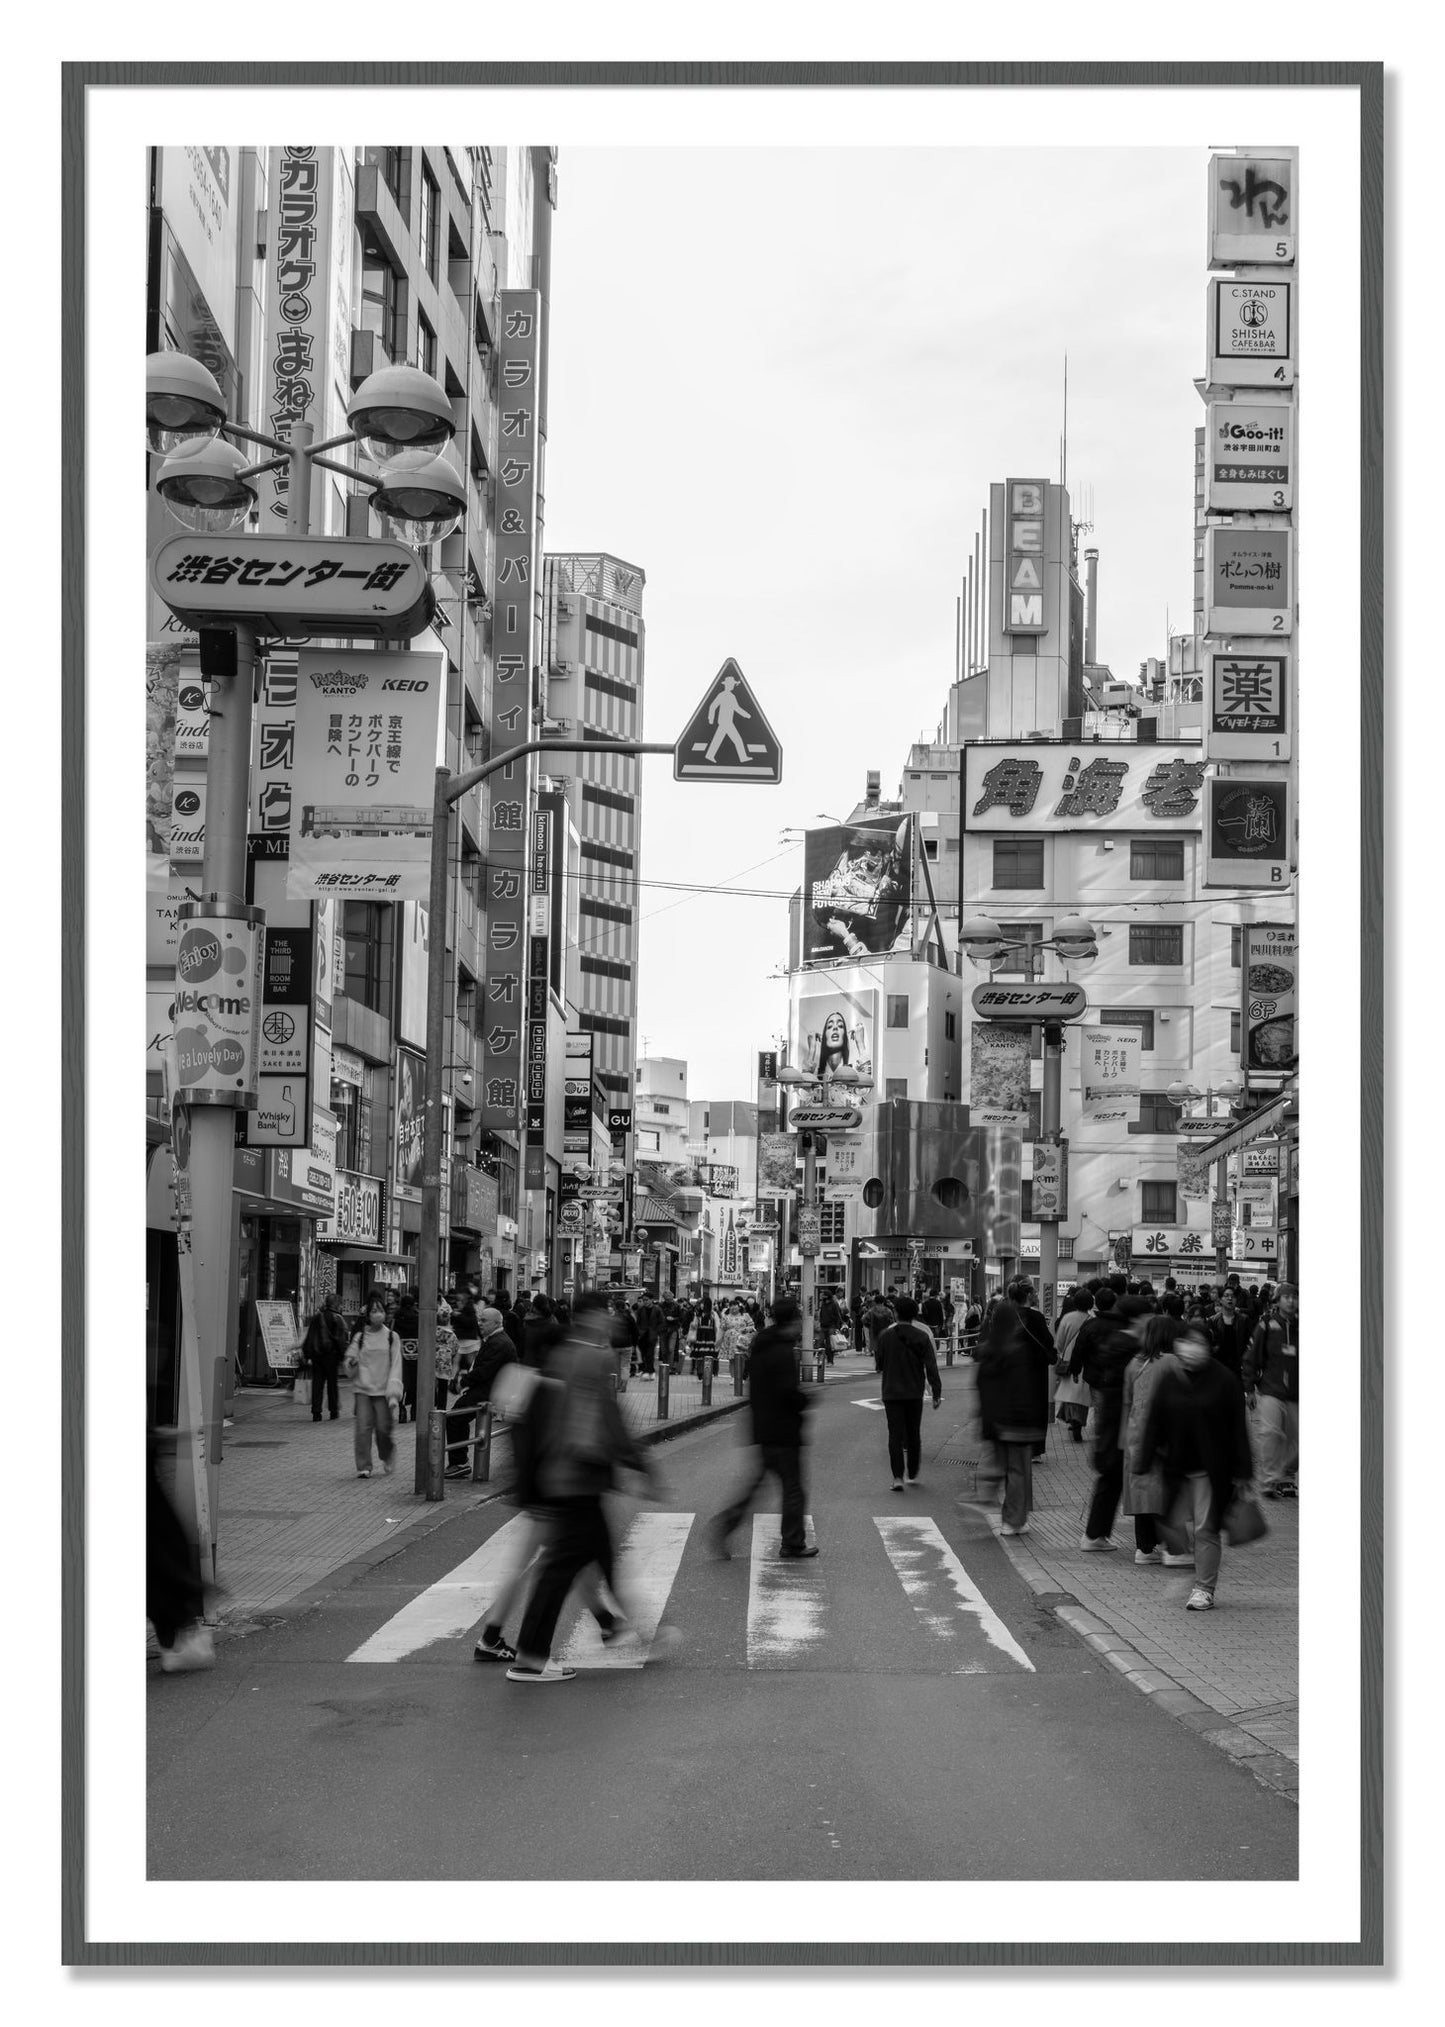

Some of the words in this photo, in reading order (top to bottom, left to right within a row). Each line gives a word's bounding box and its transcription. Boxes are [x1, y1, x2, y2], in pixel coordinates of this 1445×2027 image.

[279, 158, 318, 294] カラオケ
[1275, 242, 1287, 258] 5
[1232, 288, 1276, 299] C.STAND
[1231, 328, 1275, 339] SHISHA
[1273, 366, 1286, 381] 4
[1230, 424, 1284, 440] Goo-it!
[1223, 443, 1281, 453] 渋谷宇田川町店
[1219, 468, 1285, 480] 全身もみほぐし
[1273, 490, 1285, 507] 3
[1012, 483, 1043, 626] BEAM
[167, 553, 411, 592] 渋谷センター街
[1272, 614, 1284, 631] 2
[322, 686, 357, 695] KANTO
[381, 678, 430, 693] KEIO
[1222, 662, 1273, 713] 薬
[327, 713, 343, 756] 冒険へ
[345, 713, 363, 787] カントーの
[364, 713, 383, 787] ポケパーク
[386, 715, 404, 773] 京王線で
[1272, 740, 1280, 757] 1
[972, 757, 1208, 817] 角海老
[535, 815, 546, 851] kimono
[314, 873, 403, 887] 渋谷センター街
[1270, 867, 1283, 882] B
[270, 947, 293, 955] THIRD
[273, 940, 289, 948] THE
[180, 941, 219, 977] Enjoy
[270, 975, 291, 983] ROOM
[272, 984, 288, 993] BAR
[486, 870, 521, 1110] カラオケ館
[176, 990, 250, 1015] Welcome
[979, 991, 1081, 1005] 渋谷センター街
[1249, 1002, 1277, 1020] 6F
[193, 1046, 223, 1067] Lovely
[223, 1043, 243, 1063] Day!
[262, 1060, 283, 1068] SAKE
[286, 1060, 302, 1068] BAR
[257, 1120, 277, 1130] Bank
[258, 1111, 291, 1124] Whisky
[610, 1114, 631, 1126] GU
